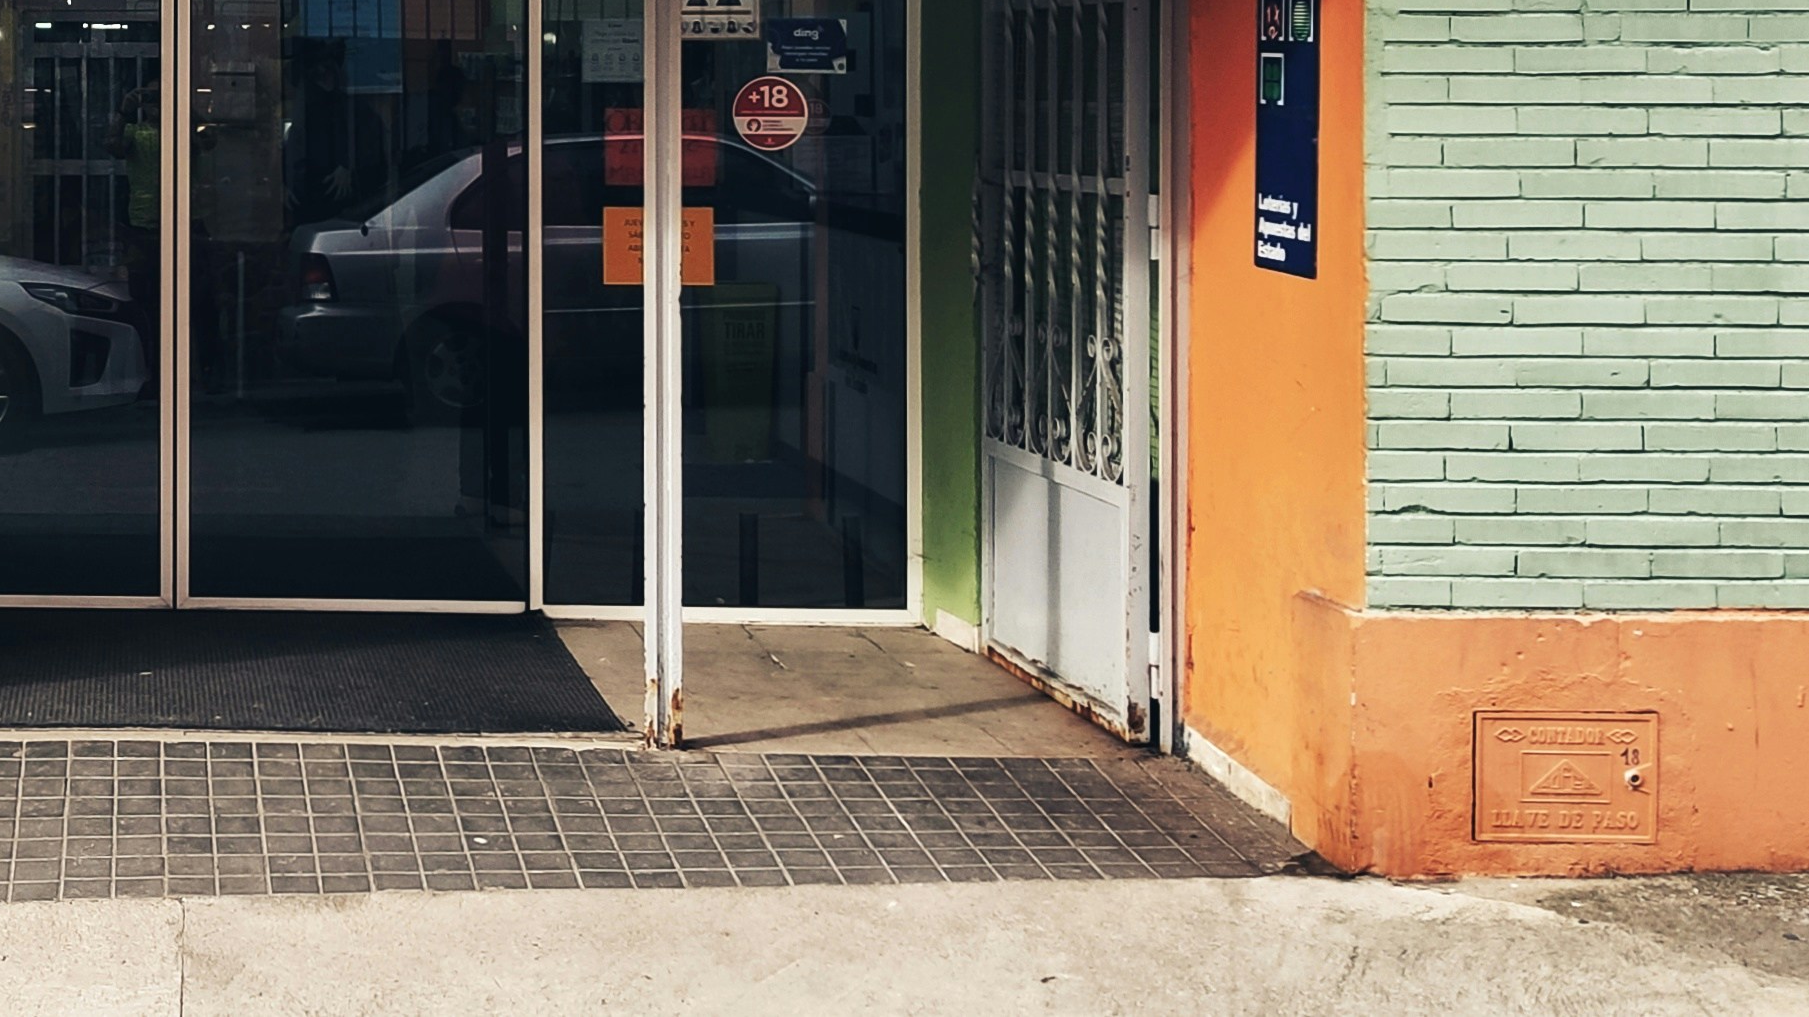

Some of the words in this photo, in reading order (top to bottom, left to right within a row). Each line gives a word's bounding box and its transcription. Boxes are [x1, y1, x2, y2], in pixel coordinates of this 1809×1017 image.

[792, 28, 820, 41] ding
[747, 85, 789, 108] +18
[724, 321, 766, 339] TIRAR
[1620, 748, 1640, 766] 18
[1558, 809, 1583, 829] DE
[1592, 810, 1640, 830] PASO
